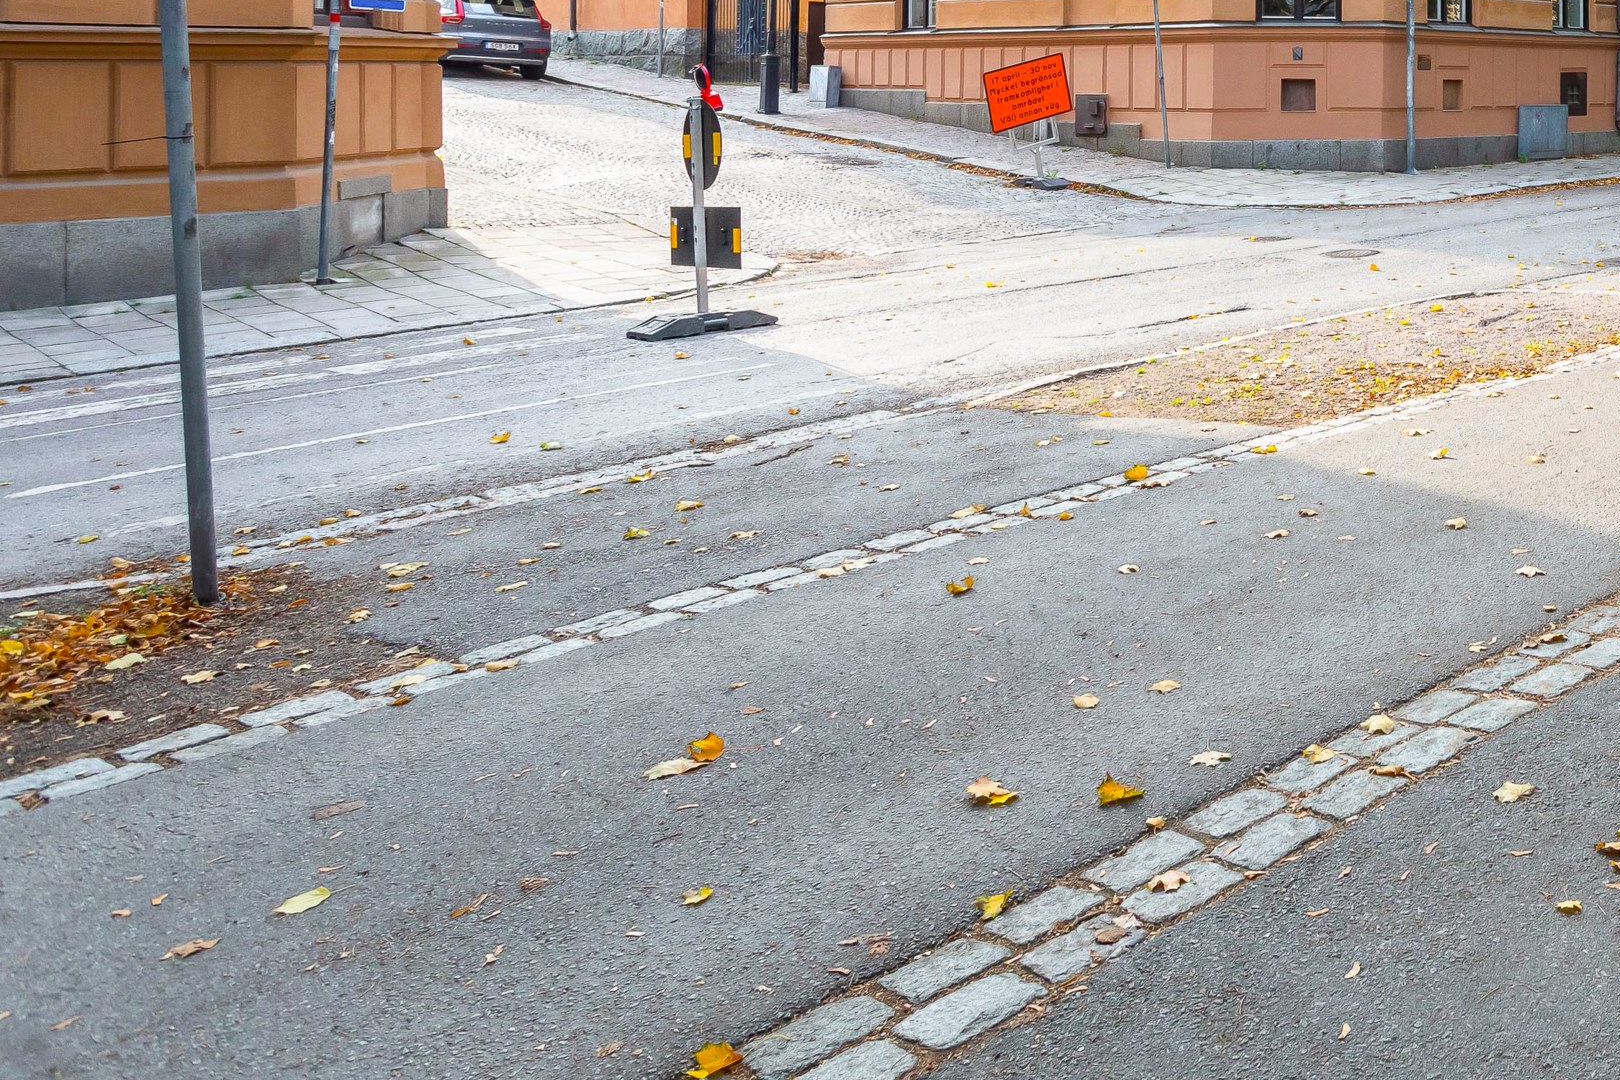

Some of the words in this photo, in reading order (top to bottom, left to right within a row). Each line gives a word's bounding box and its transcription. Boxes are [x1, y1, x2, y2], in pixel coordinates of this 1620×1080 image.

[989, 82, 1018, 96] Mycket
[1020, 70, 1062, 87] begränsad
[1002, 71, 1020, 83] april
[1030, 65, 1040, 75] 30
[1042, 62, 1057, 71] nov
[997, 82, 1054, 104] framkomlighet
[1019, 107, 1043, 119] annan
